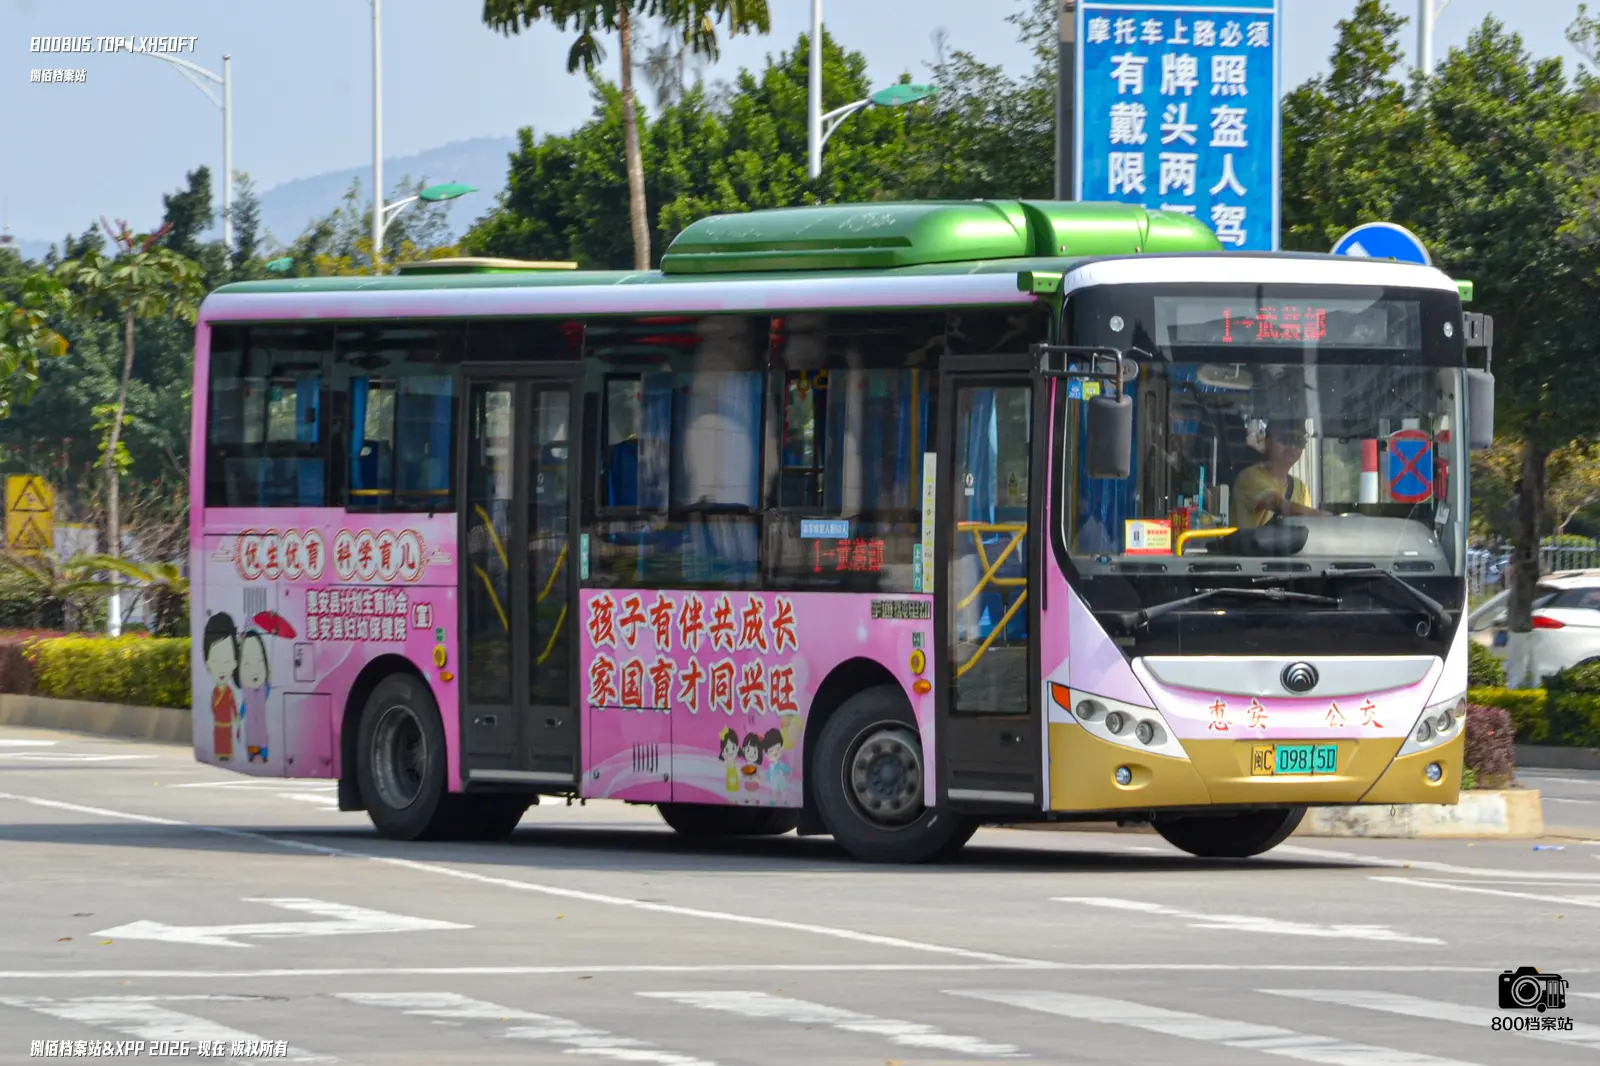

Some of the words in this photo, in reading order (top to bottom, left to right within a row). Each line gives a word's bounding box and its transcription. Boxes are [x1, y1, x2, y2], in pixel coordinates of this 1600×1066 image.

[1087, 16, 1270, 48] 摩托车上路必须
[1110, 52, 1248, 97] 有牌照
[1109, 101, 1248, 148] 戴头盔
[1108, 152, 1248, 197] 限两人
[244, 539, 321, 570] 优生优育
[336, 539, 416, 569] 科学育儿
[589, 592, 798, 652] 孩子有伴共成长
[589, 655, 798, 714] 家国育才同兴旺
[1325, 700, 1384, 729] 公交
